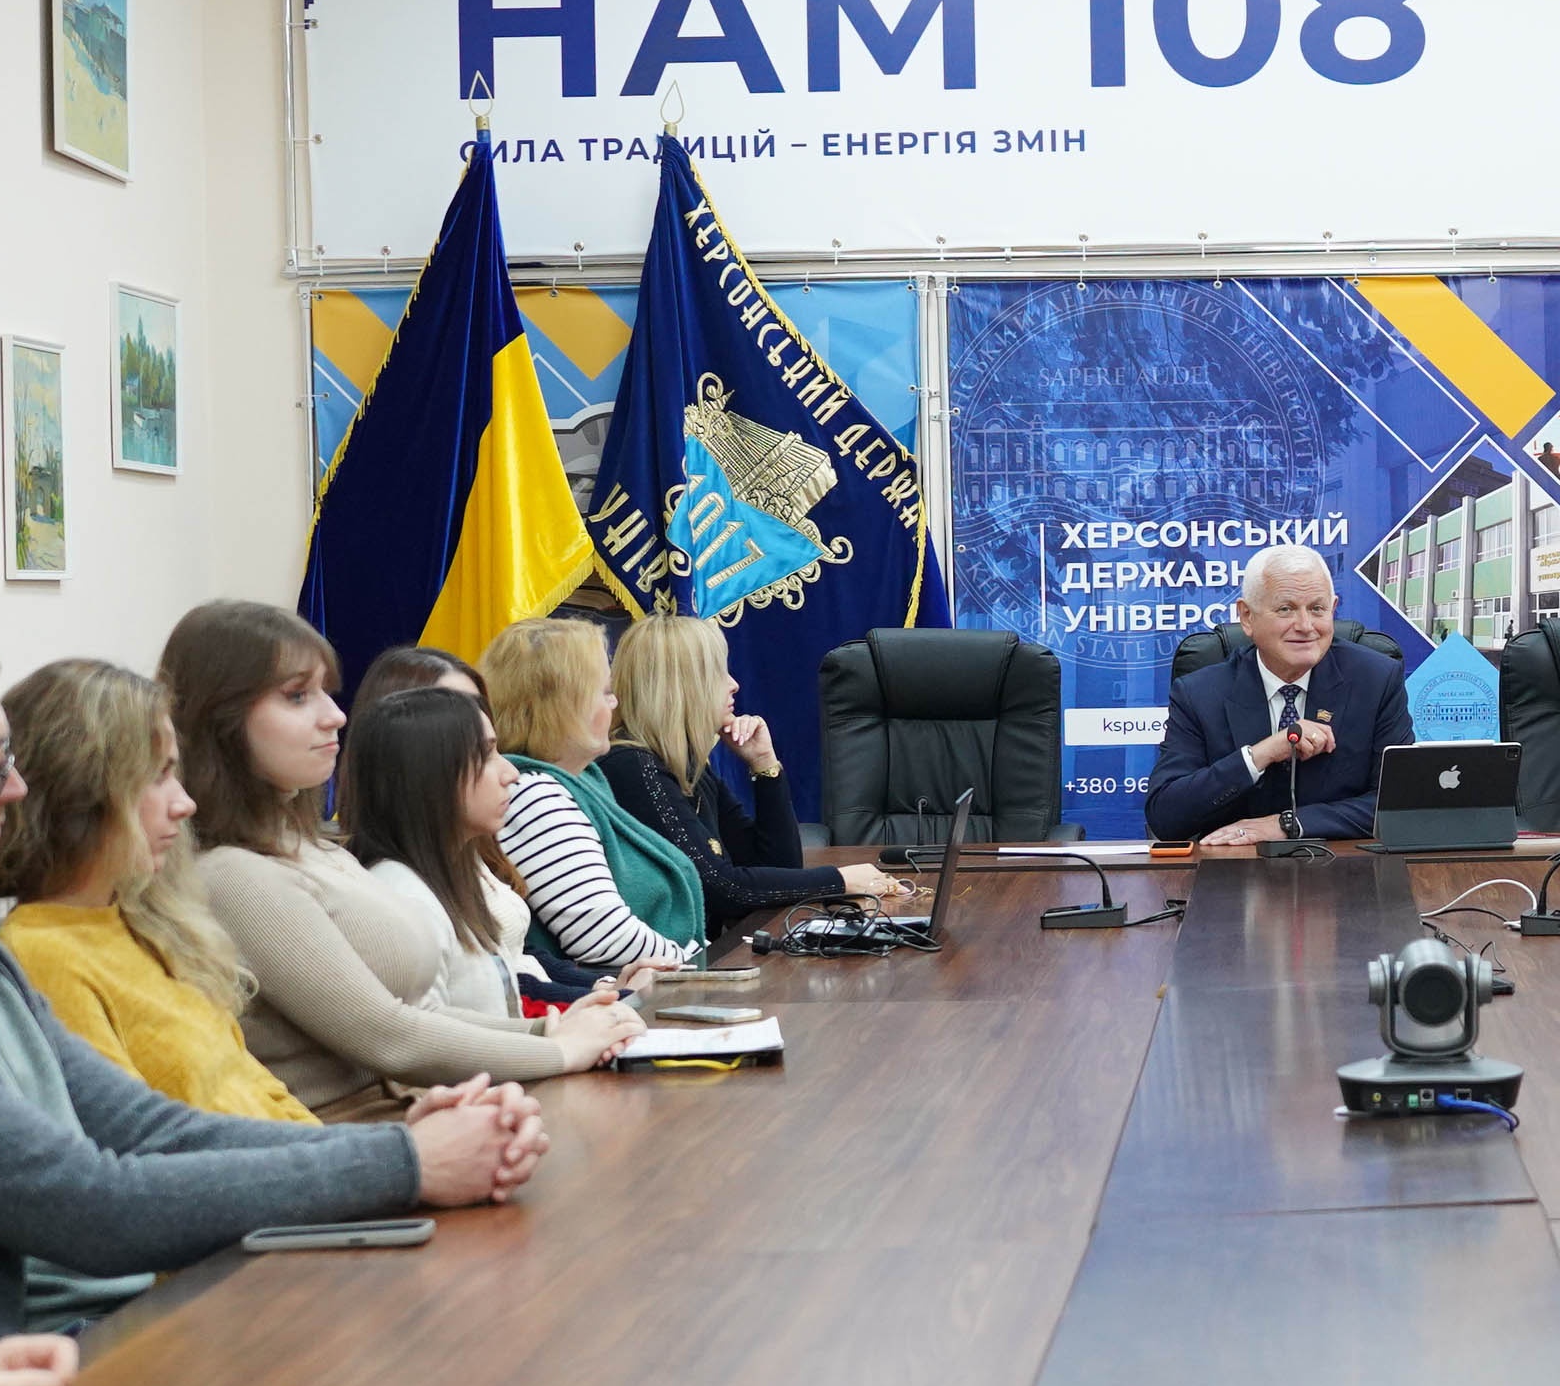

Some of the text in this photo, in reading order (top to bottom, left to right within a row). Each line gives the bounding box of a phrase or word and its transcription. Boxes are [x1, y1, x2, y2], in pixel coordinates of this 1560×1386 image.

[822, 130, 976, 157] ЕНЕРГІЯ
[992, 129, 1086, 154] ЗМІН
[684, 198, 853, 427] ХЕРСОНСЬКИЙ
[1039, 366, 1126, 388] SAPERE
[1061, 511, 1350, 550] ХЕРСОНСЬКИЙ
[1061, 560, 1248, 594] ДЕРЖАВ
[1063, 603, 1241, 633] УНІВЕРС
[1103, 717, 1169, 735] kspu.e
[1064, 777, 1117, 794] +380
